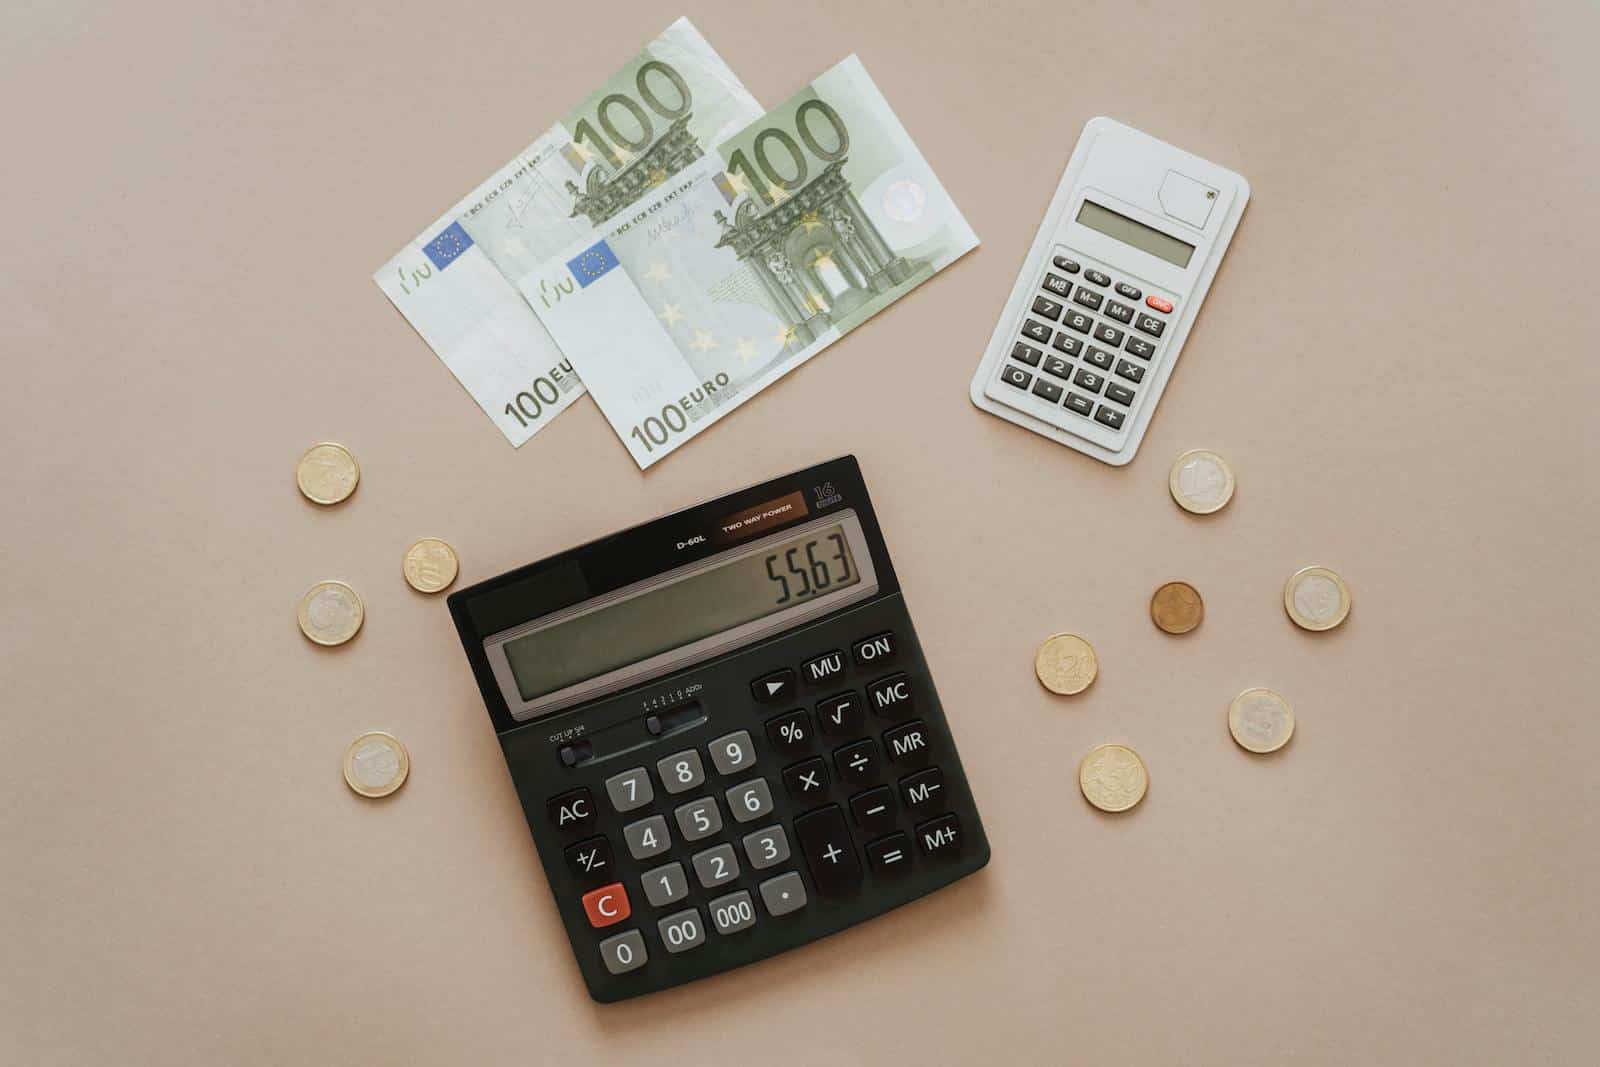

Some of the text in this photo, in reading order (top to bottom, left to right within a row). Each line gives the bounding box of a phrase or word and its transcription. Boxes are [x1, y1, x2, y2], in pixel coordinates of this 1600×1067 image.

[573, 61, 692, 171] 100
[727, 99, 849, 205] 100
[1121, 285, 1136, 295] OFF
[1043, 302, 1055, 312] 7
[1031, 326, 1042, 336] 4
[1073, 316, 1084, 327] 8
[1143, 318, 1160, 331] CE
[1063, 338, 1074, 349] 5
[1104, 329, 1115, 340] 9
[1024, 348, 1031, 358] 1
[1094, 351, 1105, 363] 6
[1012, 371, 1024, 382] 0
[1053, 361, 1064, 373] 2
[1084, 374, 1095, 386] 3
[505, 358, 573, 427] 100 EU
[631, 404, 687, 452] 100
[678, 372, 729, 411] EURO
[814, 481, 835, 499] 16
[722, 504, 793, 533] TWO WAY POWER
[676, 535, 707, 550] D-60L
[861, 637, 891, 660] ON
[810, 655, 841, 679] MU
[875, 682, 909, 708] MC
[726, 743, 743, 765] 9
[893, 732, 925, 755] MR
[676, 761, 693, 782] 8
[622, 779, 636, 801] 7
[743, 790, 761, 812] 6
[559, 800, 589, 825] AC
[693, 809, 710, 831] 5
[642, 827, 658, 848] 4
[924, 826, 956, 850] M+
[760, 838, 778, 860] 3
[710, 856, 729, 879] 2
[659, 875, 673, 896] 1
[597, 895, 618, 917] C
[716, 900, 751, 928] 000
[667, 920, 697, 945] 00
[616, 943, 633, 964] 0
